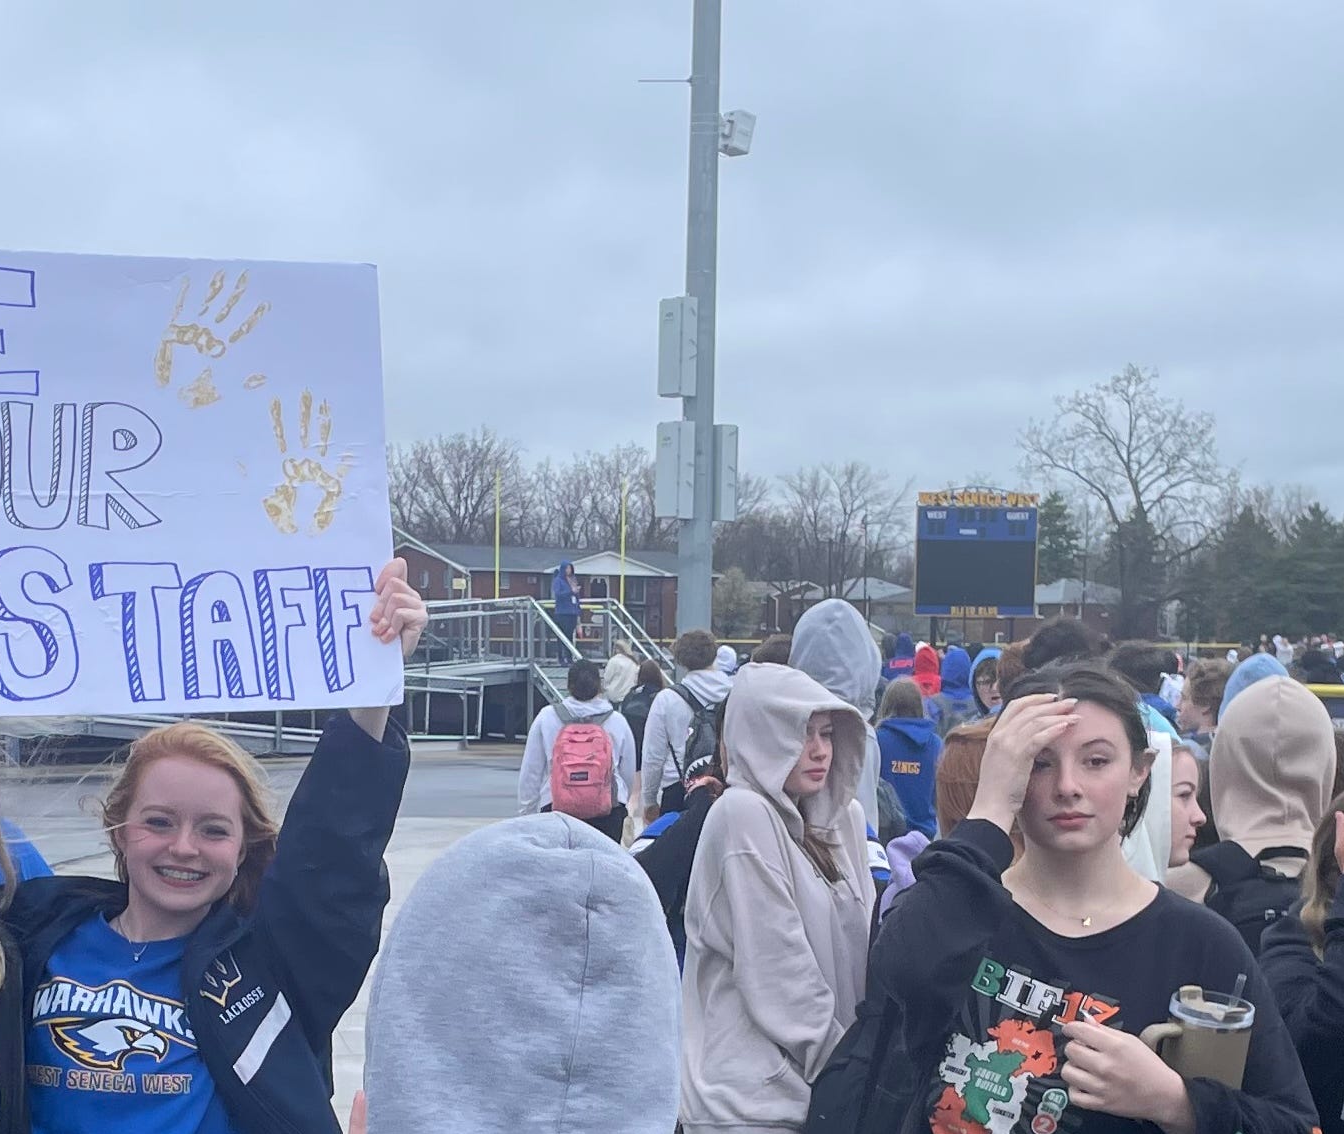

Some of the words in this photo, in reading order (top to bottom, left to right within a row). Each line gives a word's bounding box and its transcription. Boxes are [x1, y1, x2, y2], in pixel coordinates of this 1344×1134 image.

[926, 510, 948, 520] WEST
[218, 985, 266, 1025] LACROSSE
[66, 1069, 136, 1094] SENECA
[142, 1073, 194, 1095] WEST
